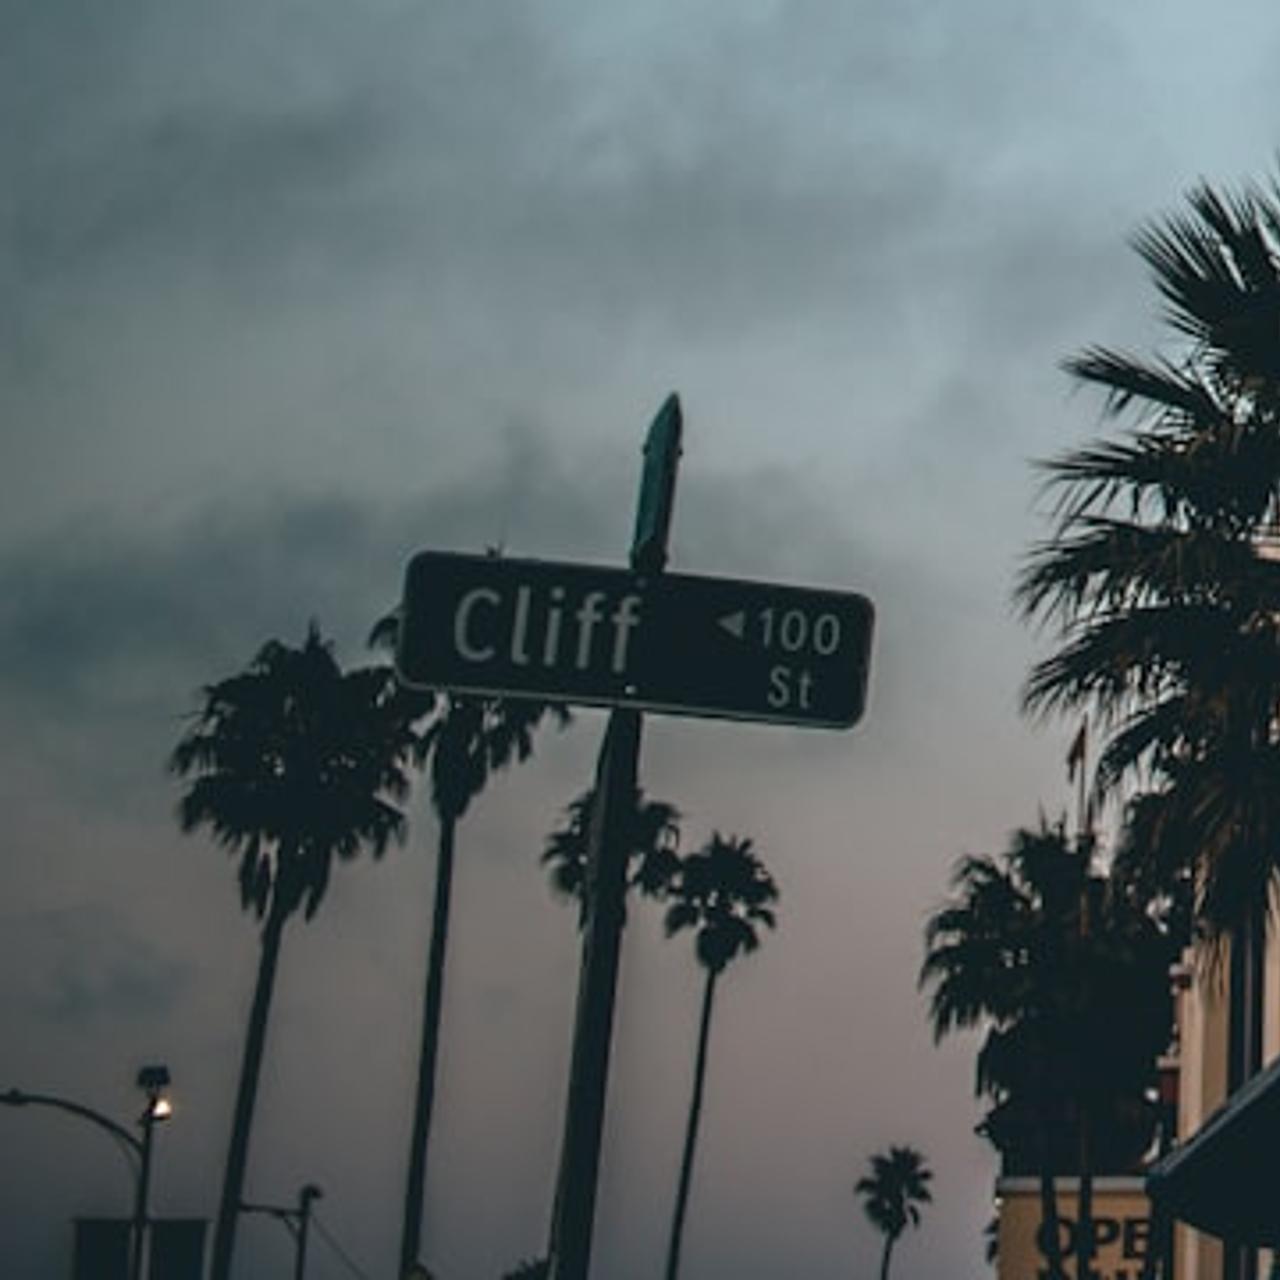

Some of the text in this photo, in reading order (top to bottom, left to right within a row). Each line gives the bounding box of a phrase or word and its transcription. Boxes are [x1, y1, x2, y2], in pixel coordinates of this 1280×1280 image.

[453, 584, 643, 674] Cliff
[758, 608, 841, 656] 100
[766, 665, 815, 710] St
